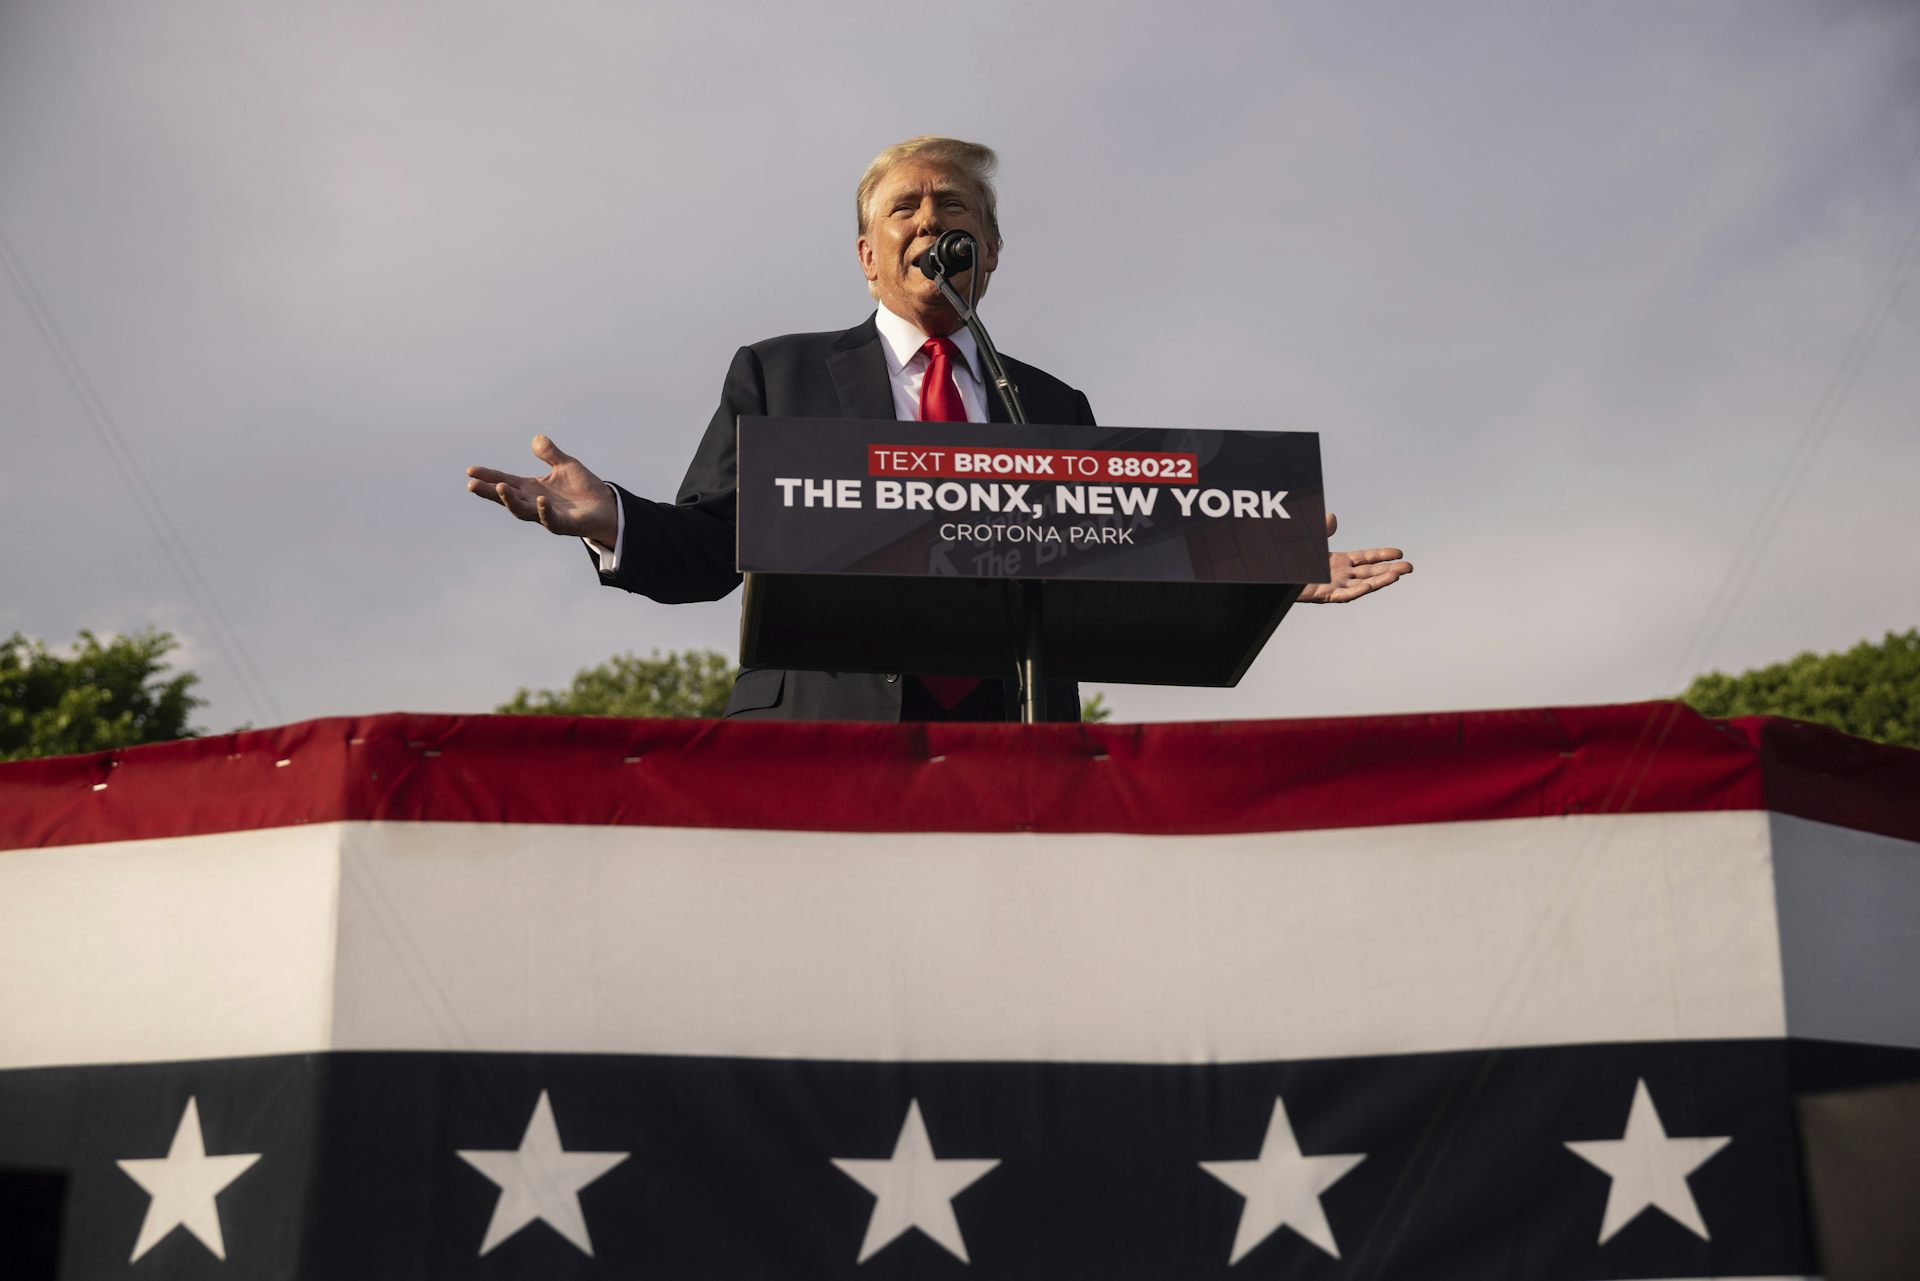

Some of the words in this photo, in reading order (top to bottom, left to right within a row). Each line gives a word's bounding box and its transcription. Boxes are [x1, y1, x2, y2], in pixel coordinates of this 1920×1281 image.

[874, 450, 945, 472] TEXT
[954, 452, 1055, 475] BRONX
[1061, 455, 1099, 476] TO
[1107, 456, 1193, 478] 88022
[774, 477, 863, 509] THE
[875, 480, 1043, 520] BRONX,
[1055, 485, 1159, 516] NEW
[1170, 487, 1291, 519] YORK
[939, 523, 1062, 543] CROTONA
[1069, 526, 1134, 545] PARK
